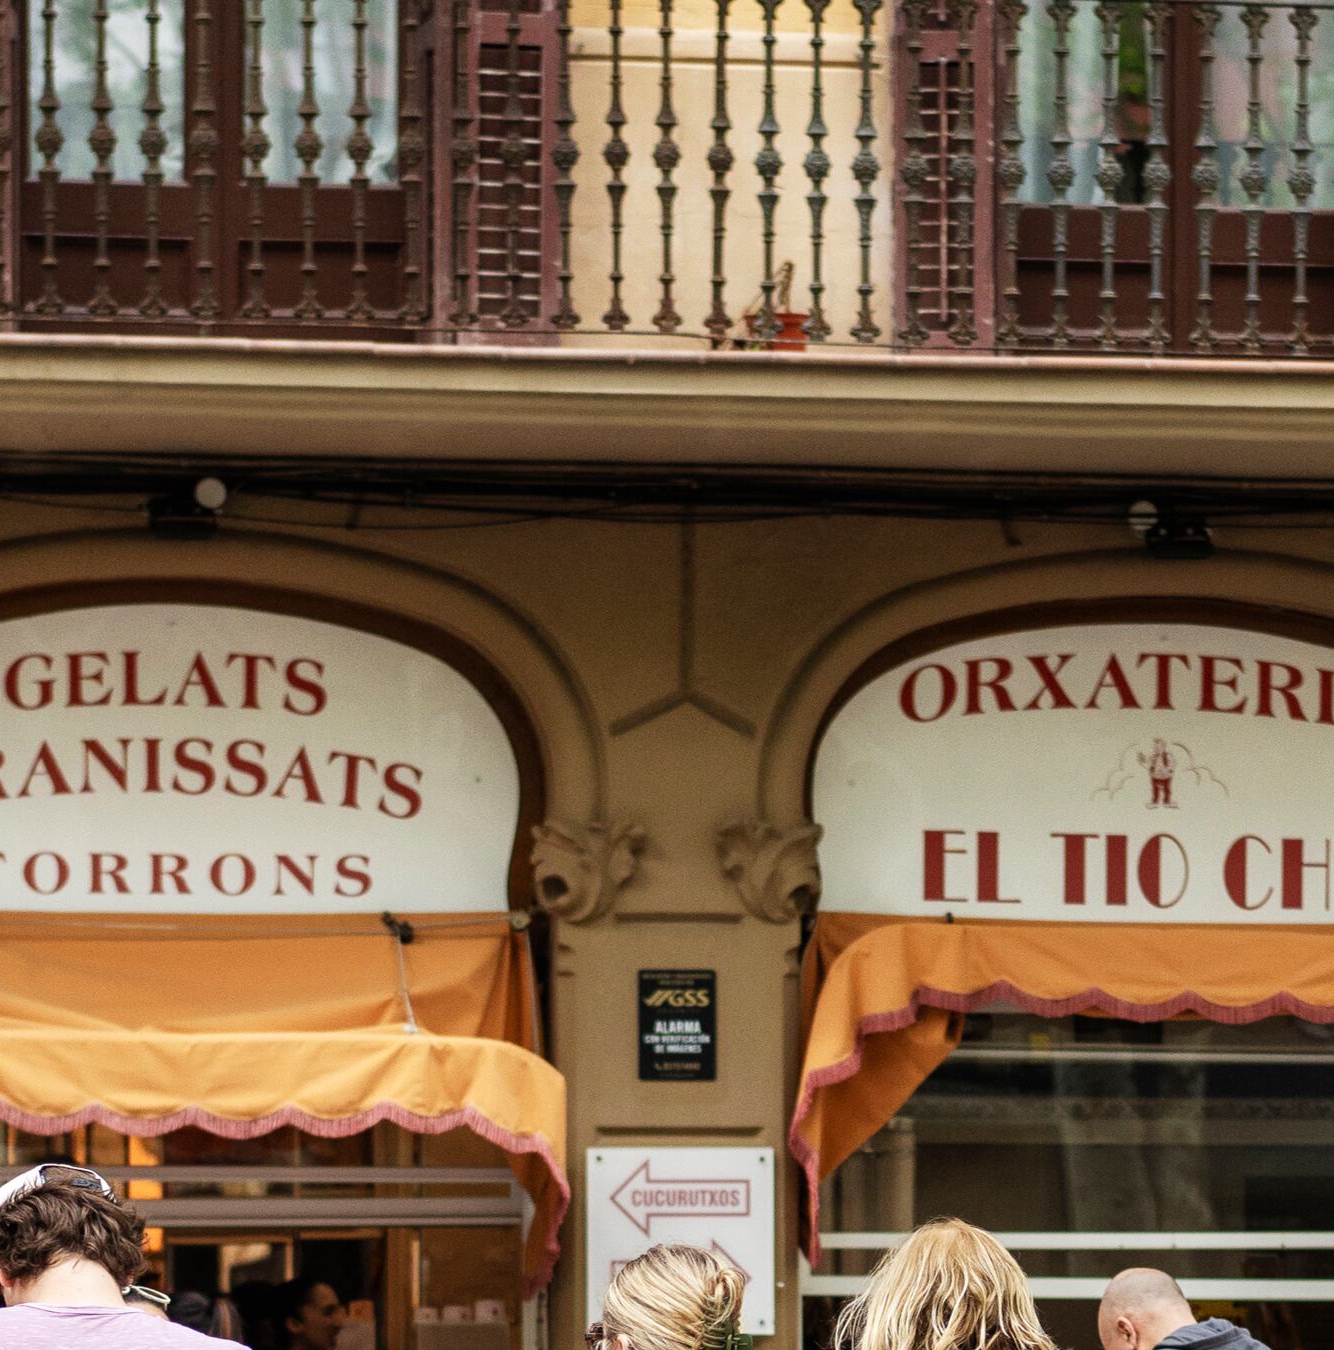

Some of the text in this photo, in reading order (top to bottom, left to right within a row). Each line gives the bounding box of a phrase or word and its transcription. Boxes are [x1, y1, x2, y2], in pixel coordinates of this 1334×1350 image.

[3, 650, 328, 716] GELATS
[922, 829, 1021, 904] EL
[1051, 832, 1189, 909] TIO
[654, 1020, 702, 1034] ALARMA
[631, 1188, 740, 1208] CUCURUTXOS
